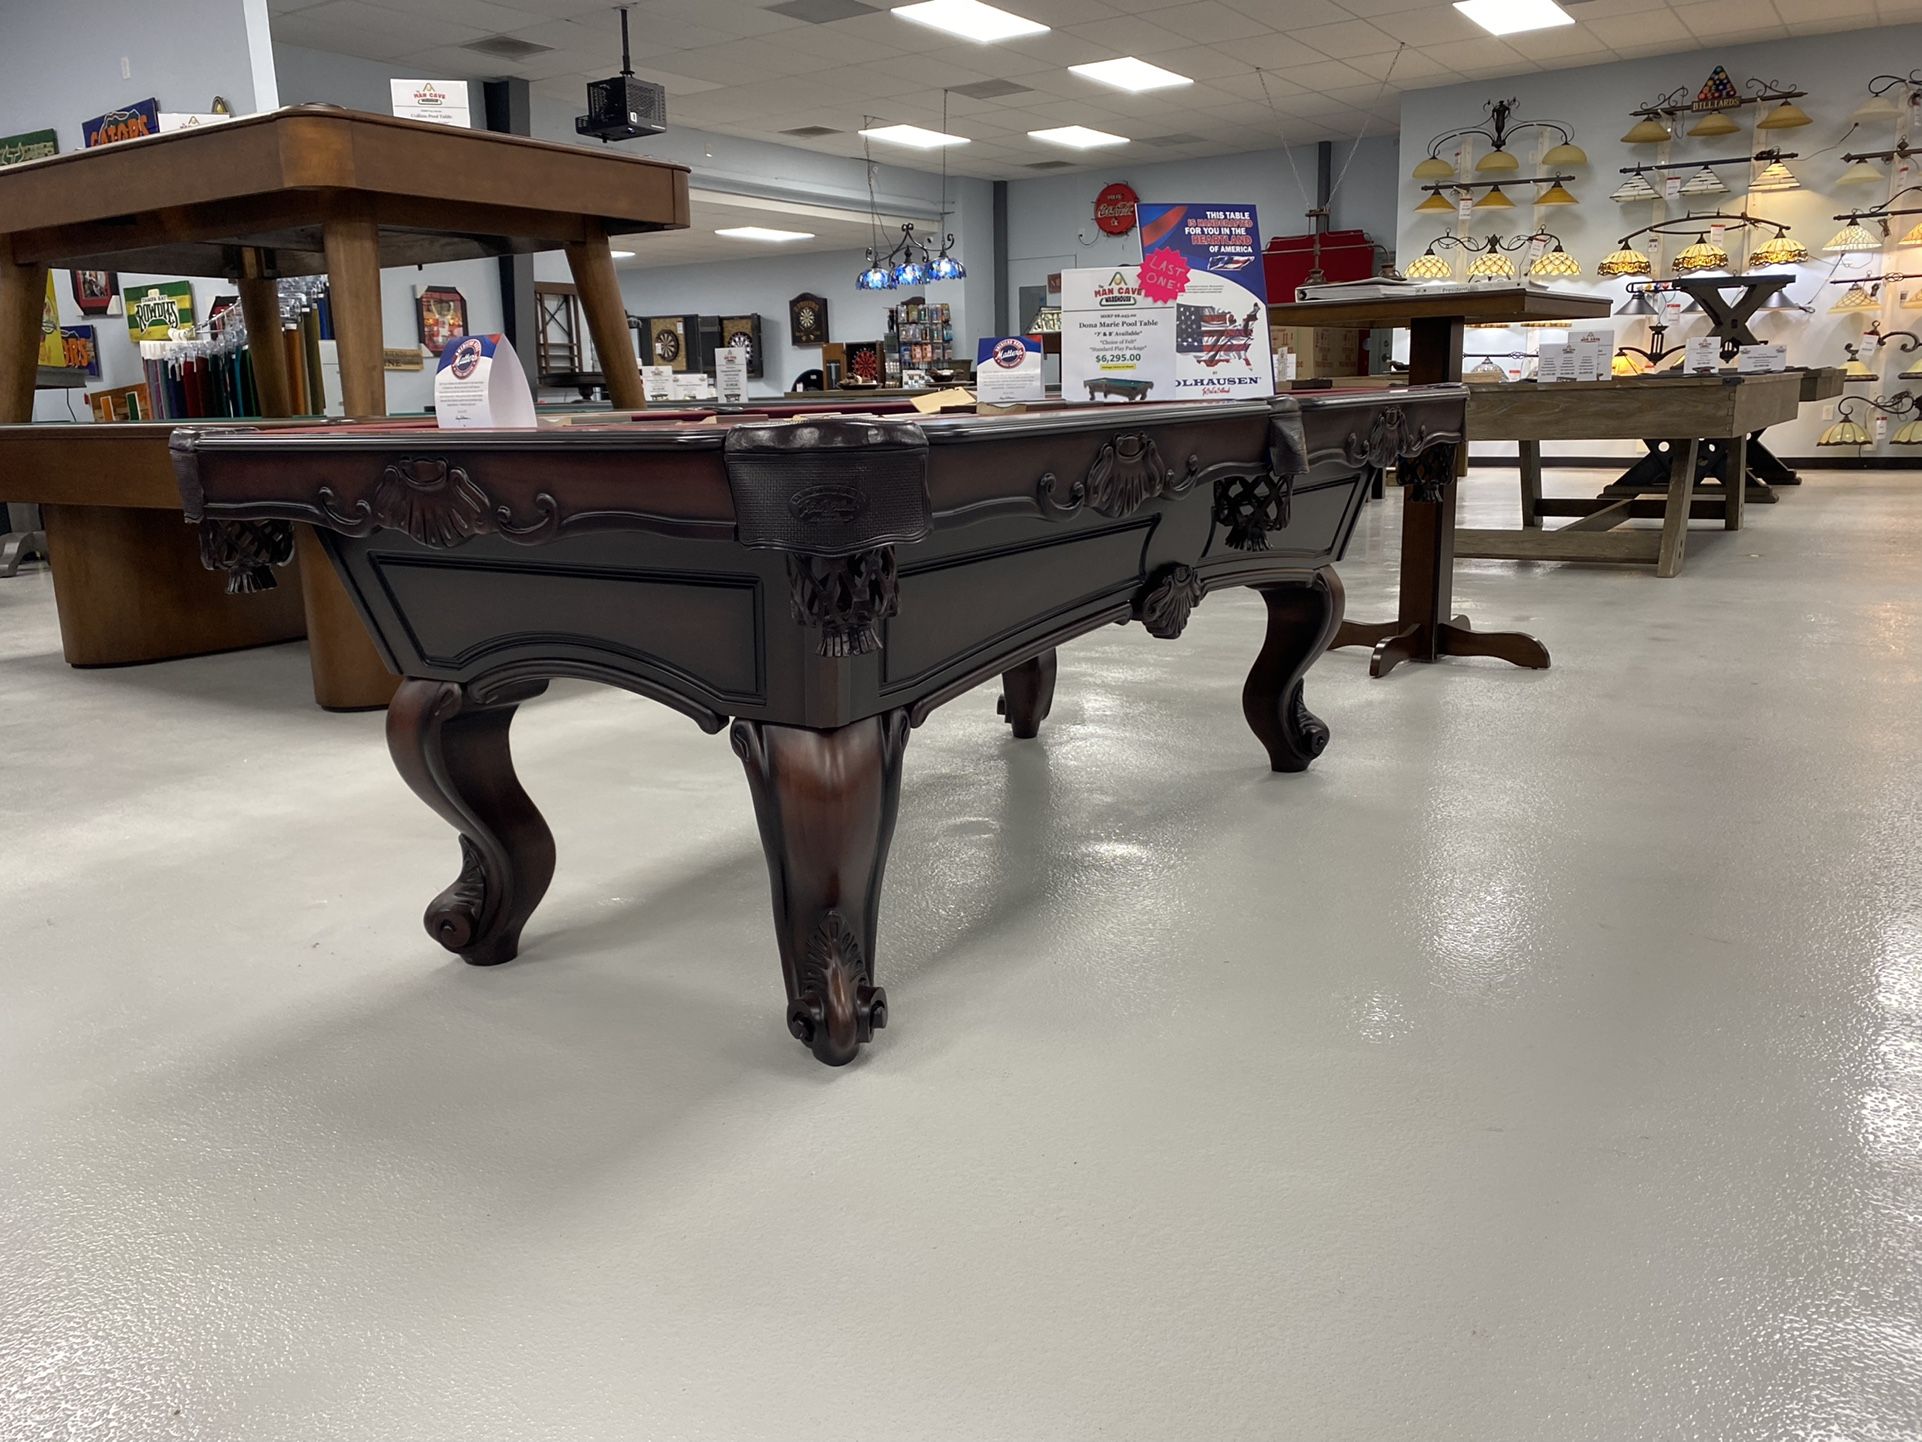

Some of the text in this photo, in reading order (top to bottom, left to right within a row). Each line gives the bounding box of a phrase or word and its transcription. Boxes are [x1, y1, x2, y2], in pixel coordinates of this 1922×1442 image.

[1693, 99, 1738, 111] BILLIARDS
[1206, 211, 1250, 219] THIS TABLE
[1185, 227, 1201, 235] FOR
[1203, 227, 1220, 235] YOU
[1191, 235, 1253, 245] HEARTLAND
[1220, 245, 1253, 253] AMERICA
[1150, 255, 1186, 276] LAST
[1094, 286, 1142, 298] MAN CAVE
[136, 301, 178, 333] ROWDIES
[1079, 319, 1158, 329] Dona Marie Pool Table
[1095, 352, 1141, 364] $6,295.00
